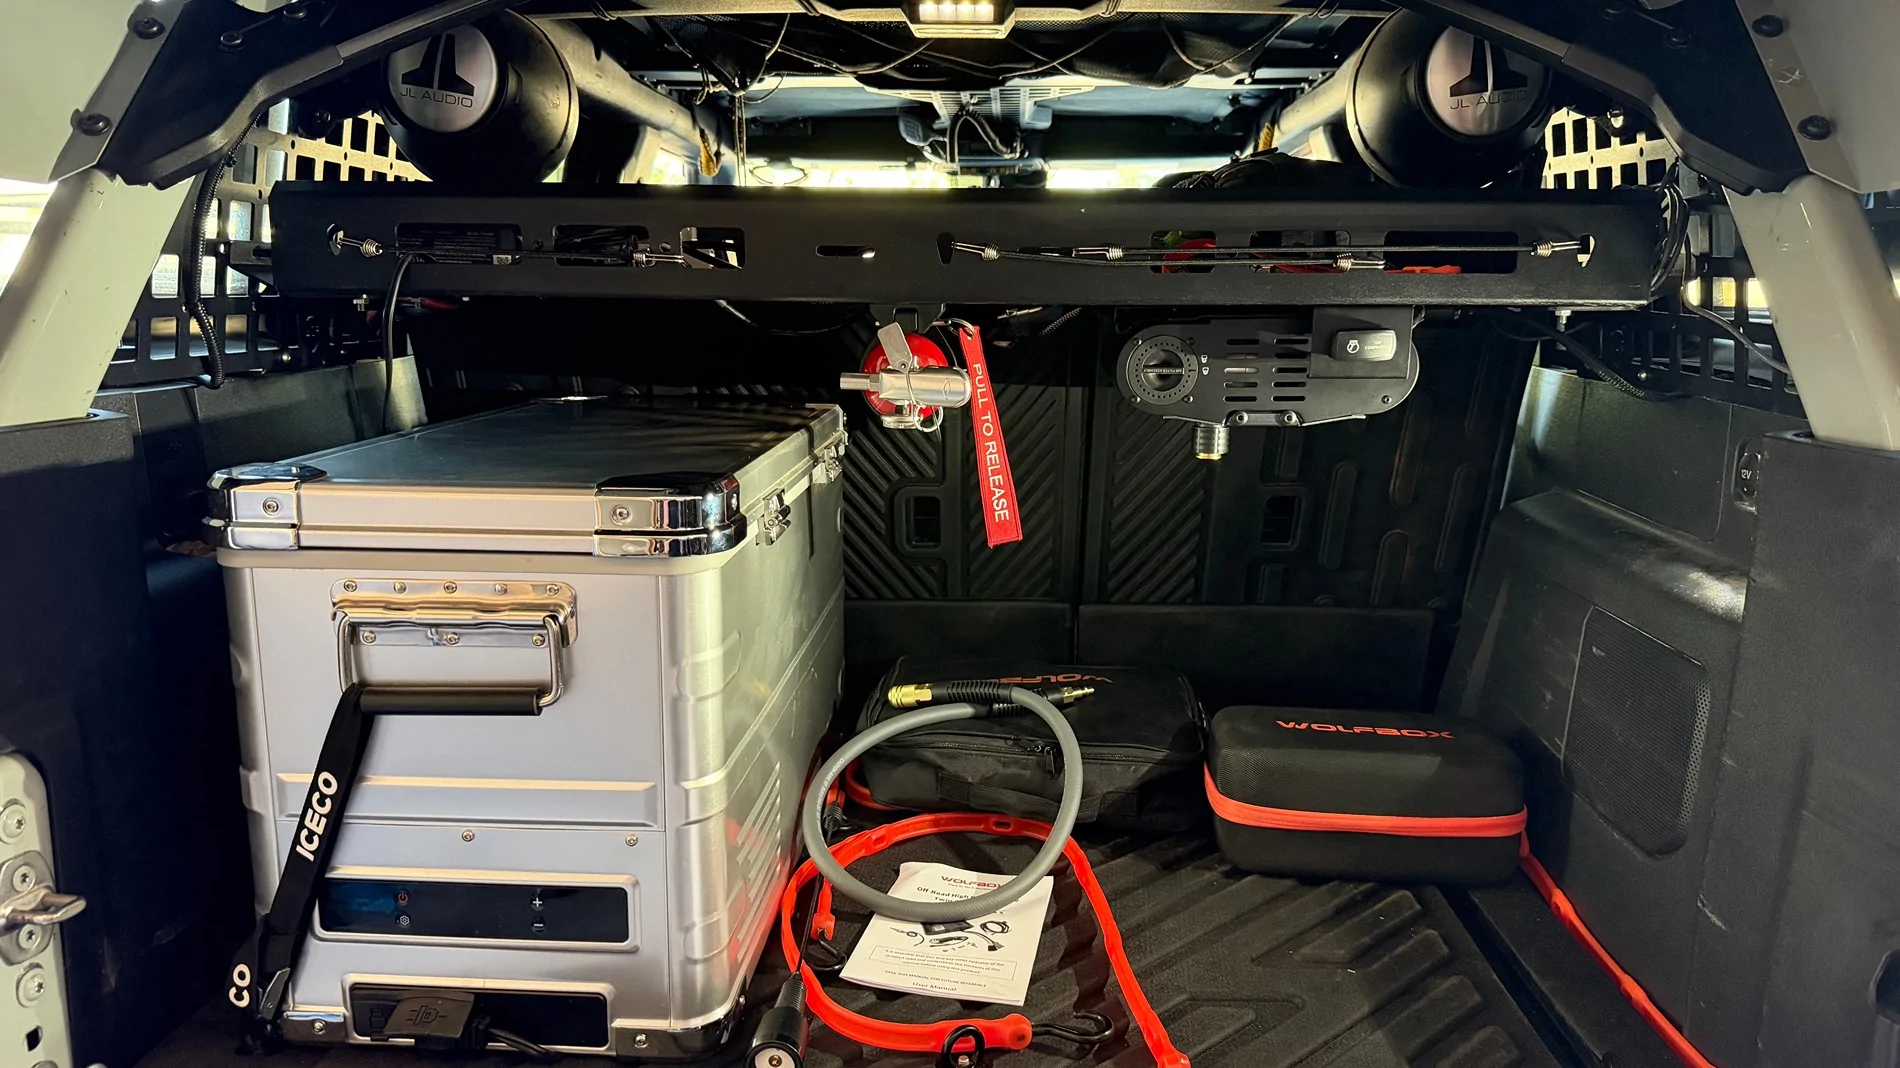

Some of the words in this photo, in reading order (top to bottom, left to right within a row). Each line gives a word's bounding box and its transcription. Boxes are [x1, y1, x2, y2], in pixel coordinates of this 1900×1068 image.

[401, 87, 417, 99] JL
[421, 90, 474, 108] AUDIO
[1450, 98, 1471, 110] JL
[1476, 90, 1527, 106] AUDIO
[972, 363, 989, 409] PULL
[980, 411, 994, 437] TO
[984, 441, 1010, 522] RELEASE
[1741, 469, 1752, 480] 12V
[982, 673, 1113, 684] WOLFB
[1275, 720, 1455, 739] WOLFBOX
[295, 771, 339, 862] ICECO
[916, 886, 951, 897] Off-Road
